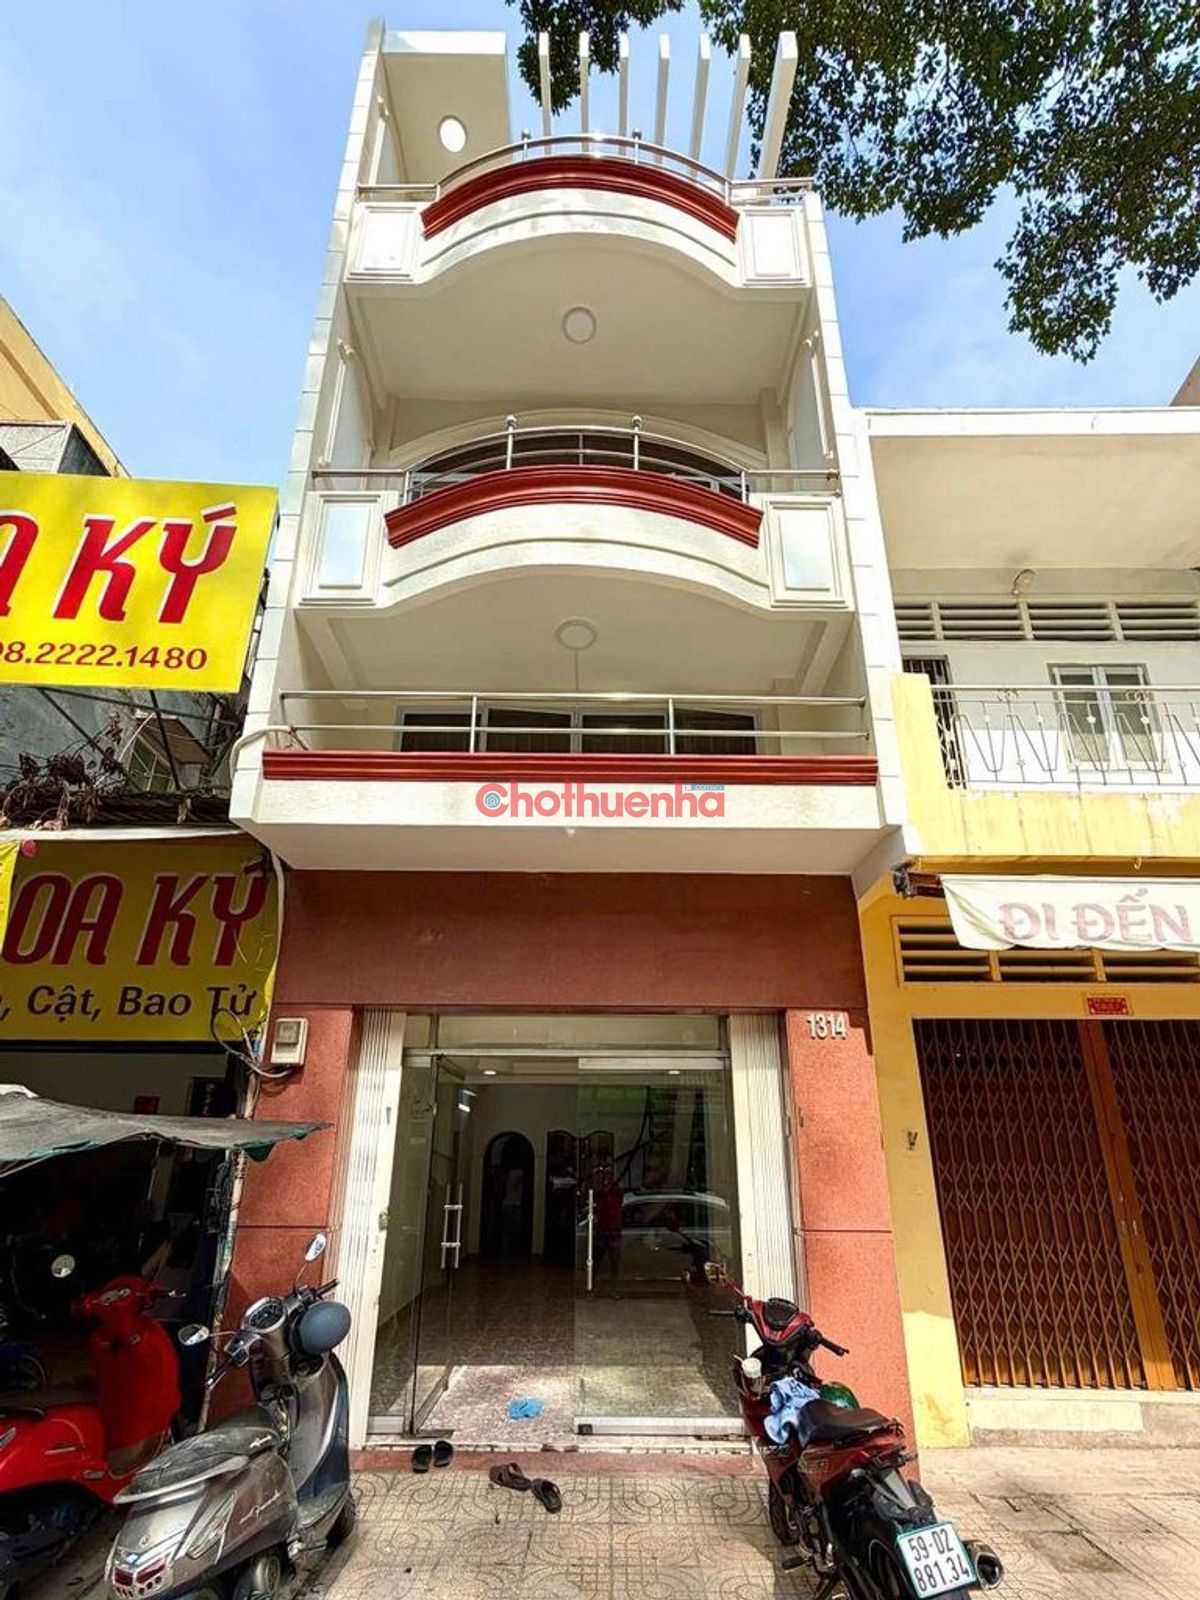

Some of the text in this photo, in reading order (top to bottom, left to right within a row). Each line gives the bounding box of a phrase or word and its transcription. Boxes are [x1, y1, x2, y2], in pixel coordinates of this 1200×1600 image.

[53, 503, 238, 624] KÝ
[0, 640, 208, 670] 8.2222.1480
[2, 859, 270, 967] OA KÝ
[999, 887, 1193, 943] ĐI ĐẾN
[27, 985, 101, 1023] Cật,
[117, 986, 192, 1016] Bao
[206, 984, 257, 1017] Tử
[806, 1013, 847, 1040] 1314
[908, 1529, 954, 1562] 59-D2
[914, 1554, 970, 1592] 881.34
